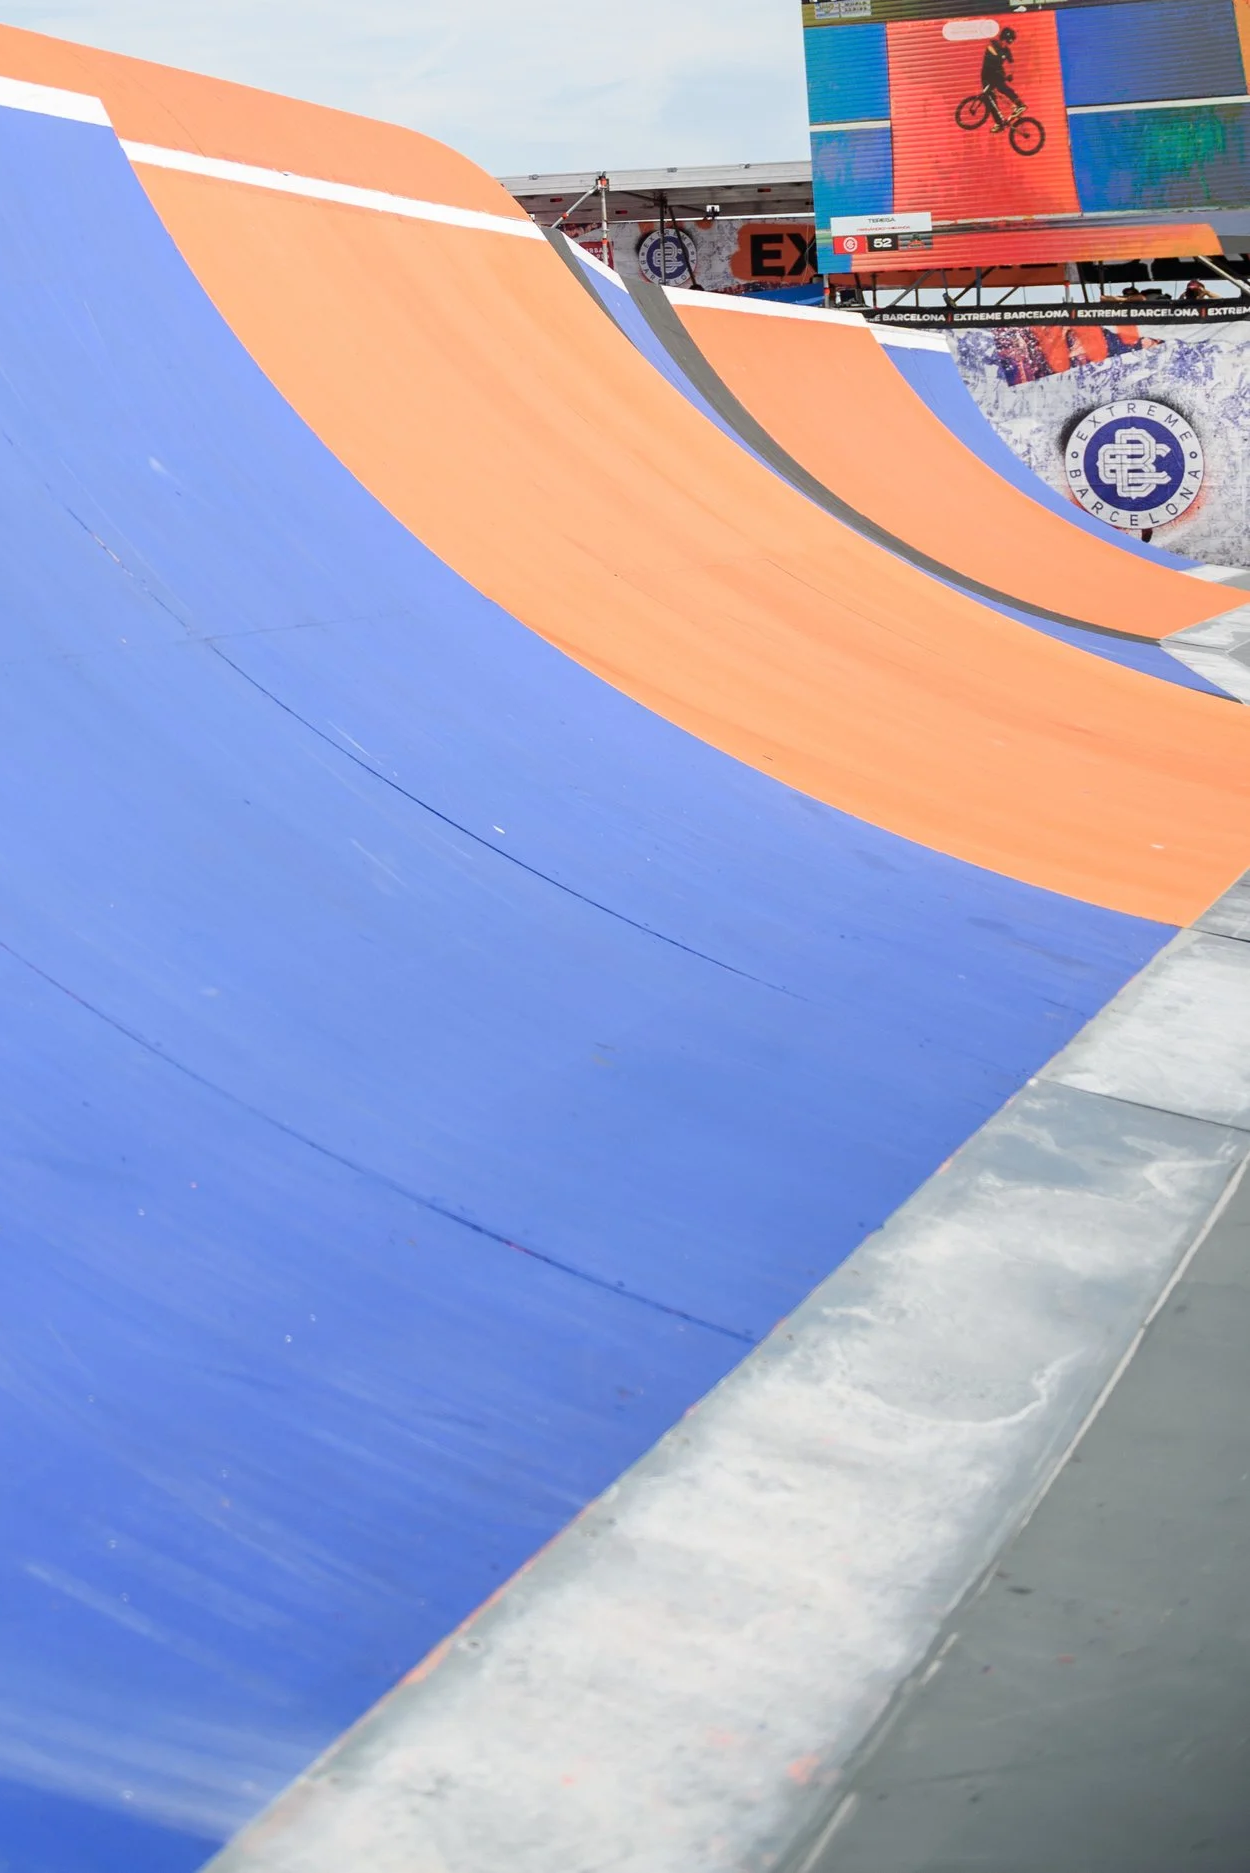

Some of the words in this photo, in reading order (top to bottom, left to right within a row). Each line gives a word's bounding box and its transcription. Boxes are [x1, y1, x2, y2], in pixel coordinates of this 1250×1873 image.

[750, 233, 818, 277] EX
[873, 237, 893, 248] 52
[882, 313, 946, 322] BARCELONA
[953, 312, 1002, 321] EXTREME
[1004, 309, 1069, 320] BARCELONA
[1077, 308, 1128, 318] EXTREME
[1130, 307, 1199, 317] BARCELONA
[1076, 403, 1193, 443] EXTREME
[1069, 468, 1201, 527] BARCELONA
